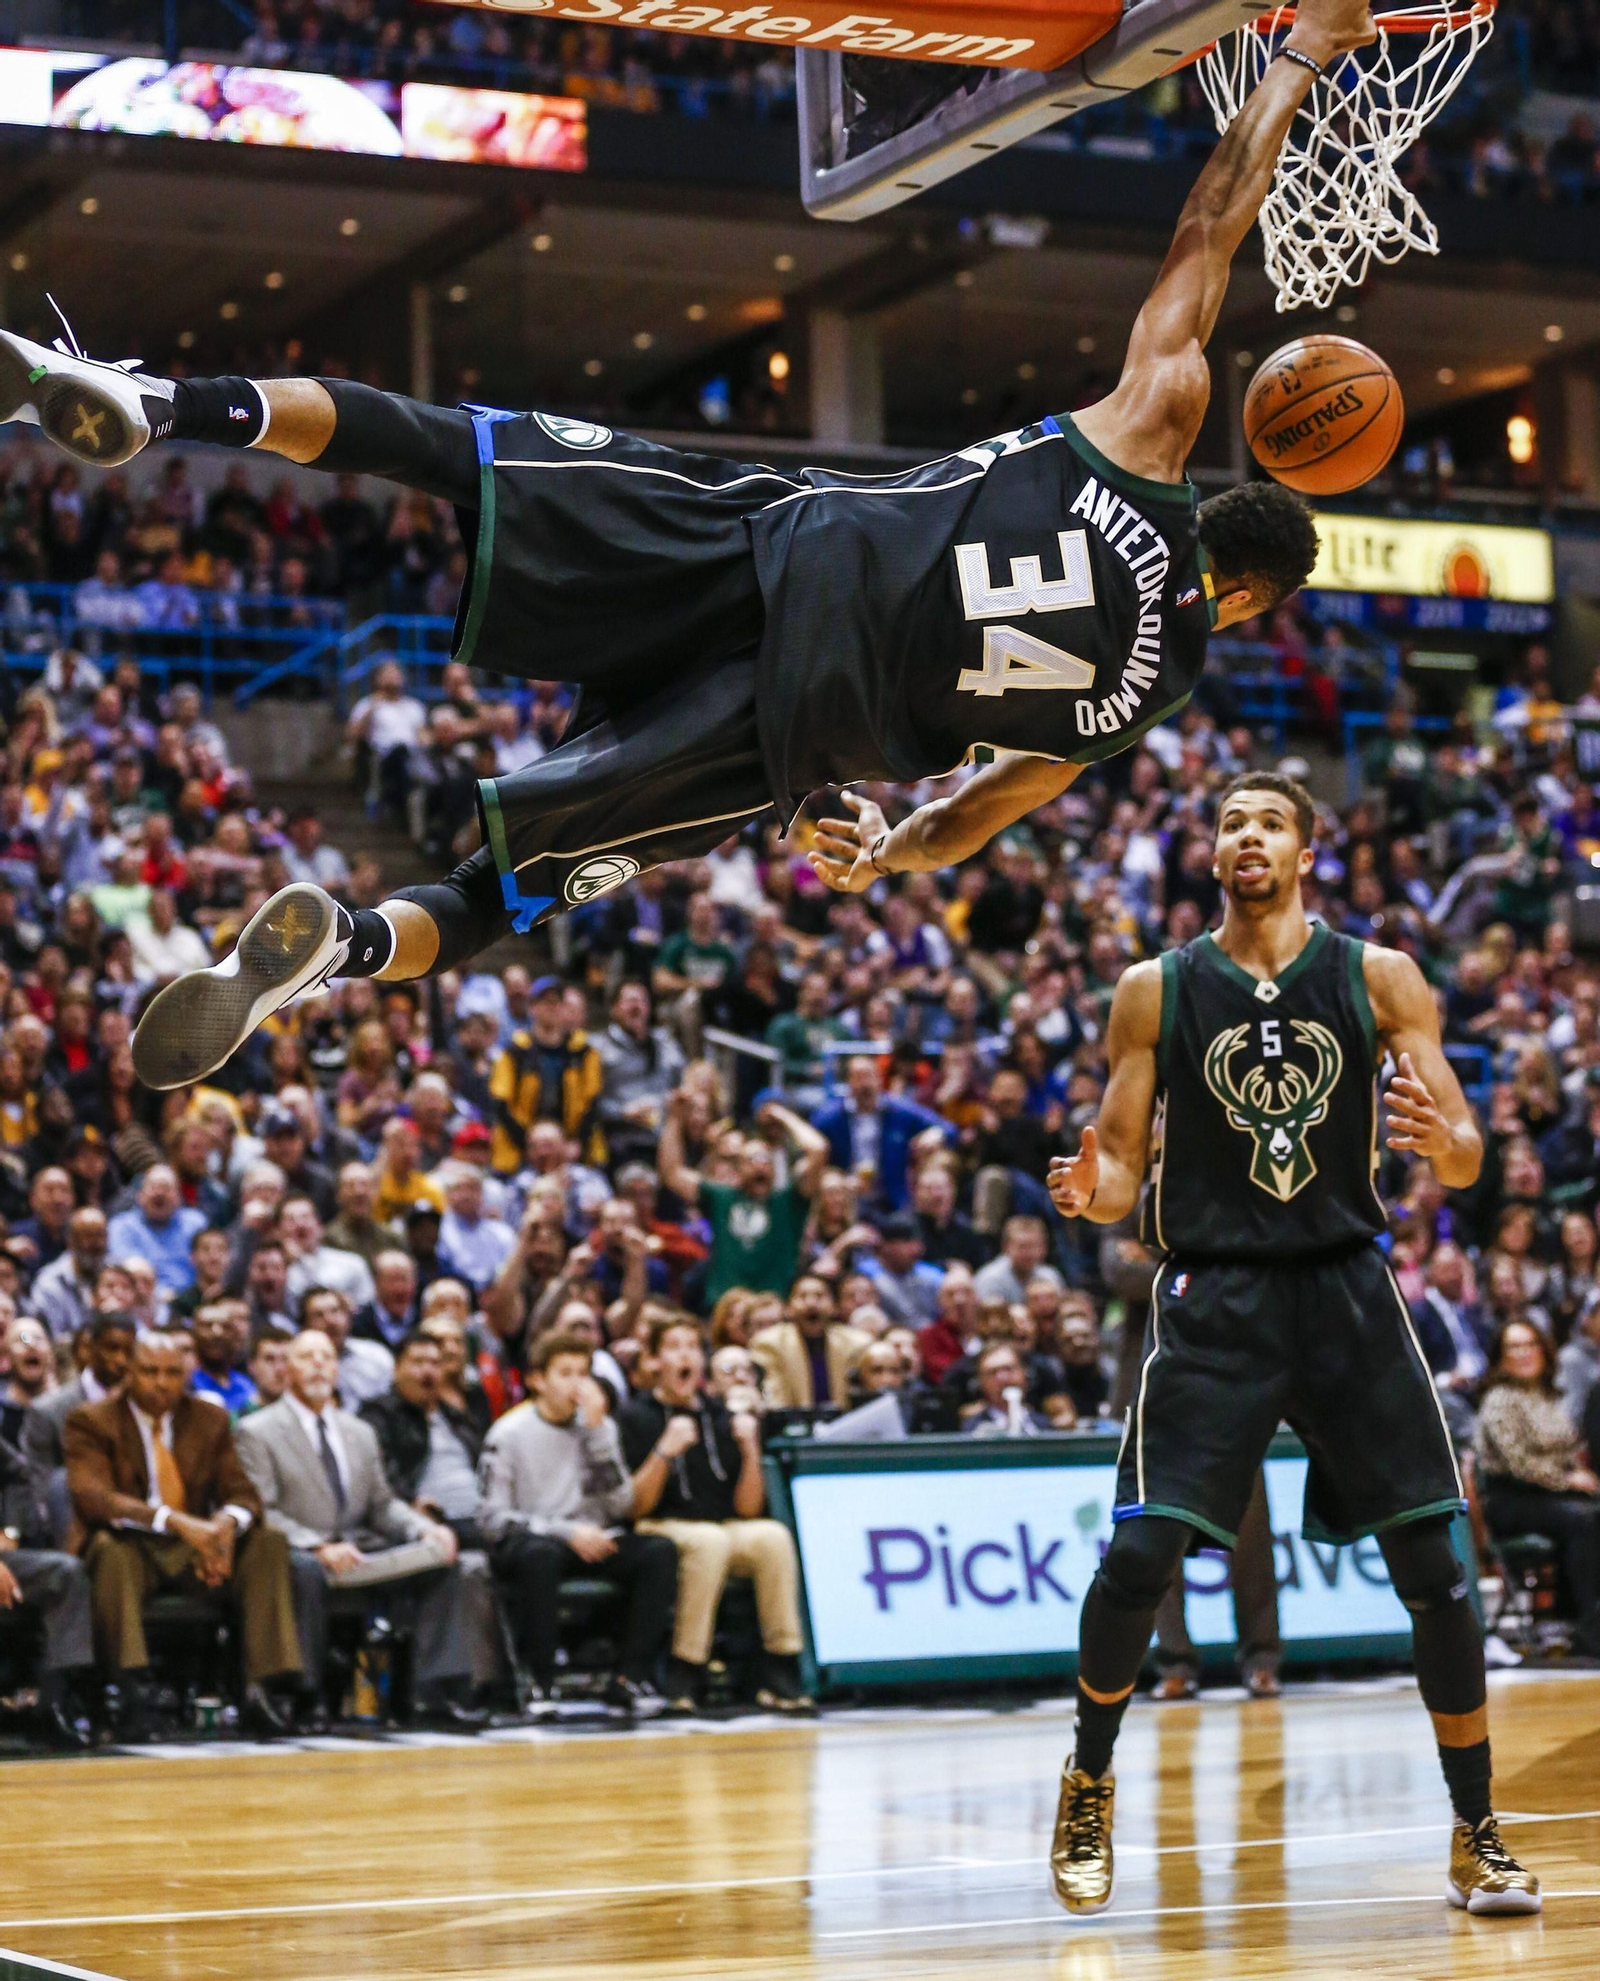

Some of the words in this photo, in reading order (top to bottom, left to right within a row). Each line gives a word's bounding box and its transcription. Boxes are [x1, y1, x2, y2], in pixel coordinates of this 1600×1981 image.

[558, 0, 811, 38] State
[796, 15, 1036, 60] Farm
[1263, 384, 1364, 460] SPALDING
[954, 528, 1097, 697] 34
[1069, 476, 1171, 736] ANTETOKOUNMPO
[1260, 1020, 1282, 1057] 5
[863, 1522, 1073, 1611] Pick
